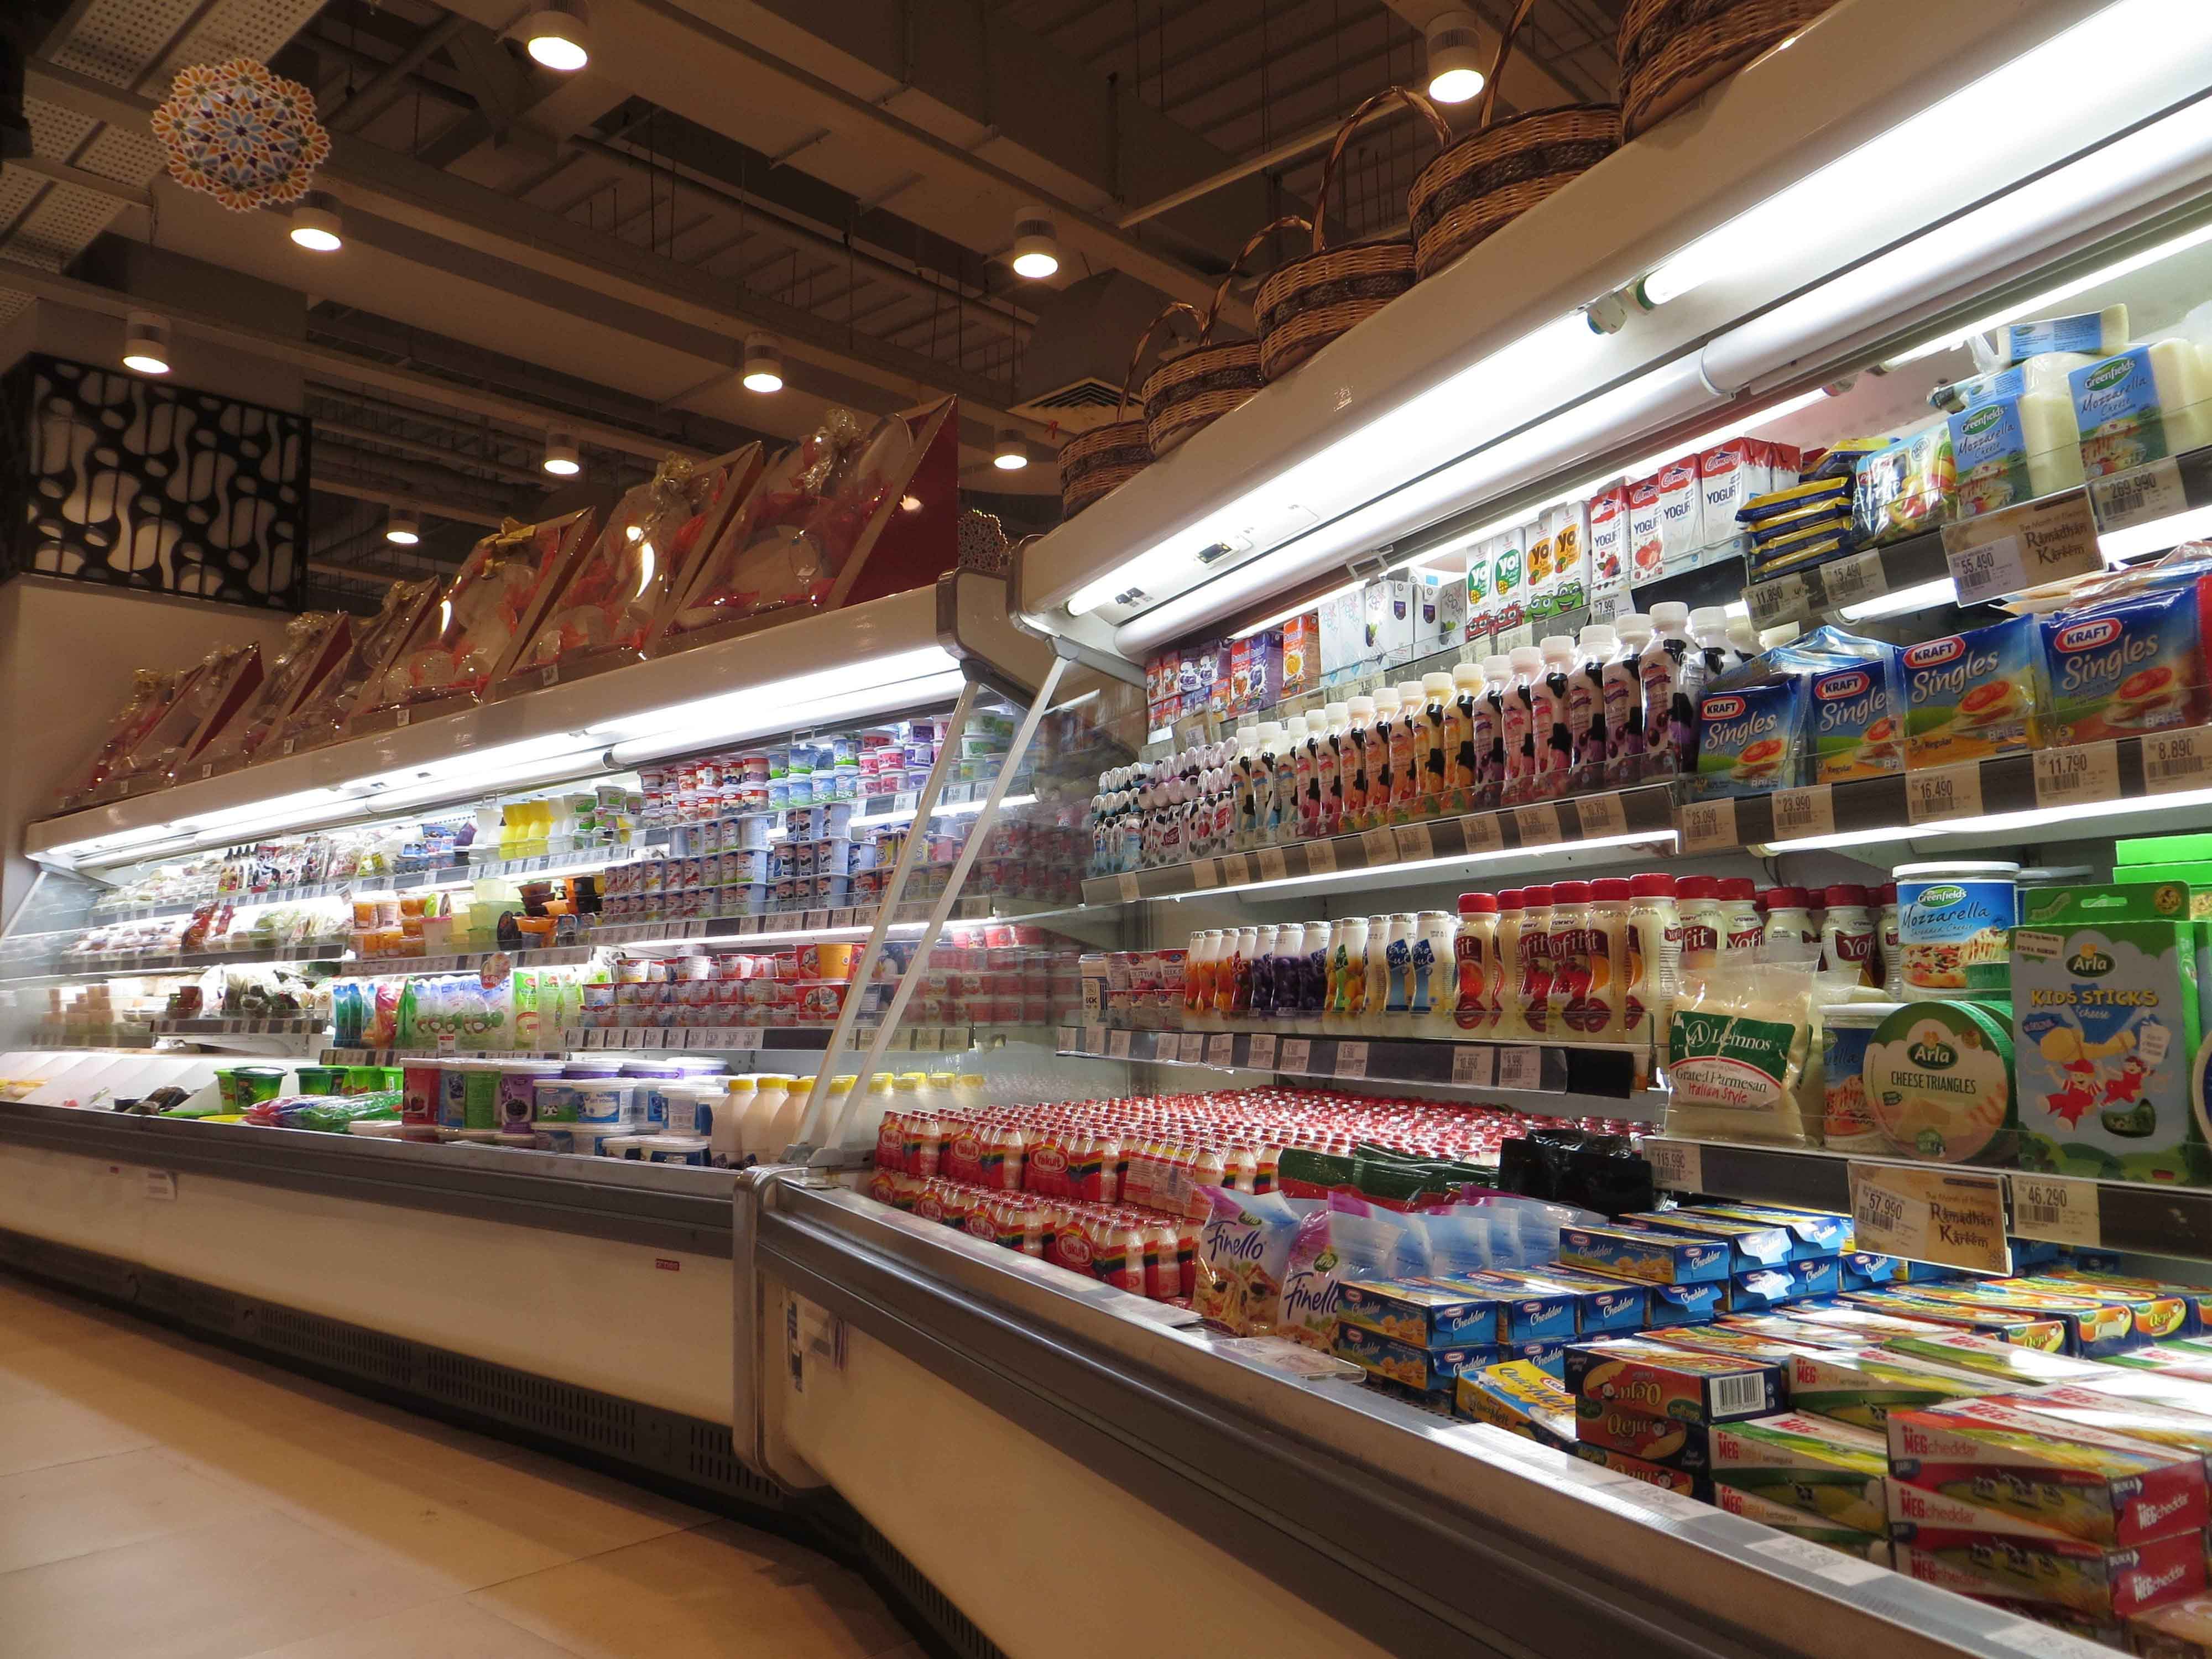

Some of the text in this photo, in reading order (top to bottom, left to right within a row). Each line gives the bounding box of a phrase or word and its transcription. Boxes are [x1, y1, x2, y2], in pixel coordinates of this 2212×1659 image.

[2085, 359, 2136, 388] Greenfields
[1961, 406, 2005, 431] Greenfields
[1707, 483, 1740, 504] YOGURT
[1664, 498, 1694, 519] YOGURT
[1634, 516, 1662, 535] YOGURT
[1594, 528, 1621, 547] YOGURT
[1960, 553, 1994, 575] 55.490
[2067, 625, 2109, 645] KRAFT
[1914, 643, 1954, 661] KRAFT
[2062, 633, 2158, 691] Singles
[1825, 678, 1859, 693] KRAFT
[1912, 649, 2000, 704] Singles
[1707, 702, 1737, 713] KRAFT
[1820, 687, 1887, 732] Single
[1705, 711, 1777, 750] Singles
[2159, 739, 2194, 760] 8.890
[2049, 755, 2087, 774] 11.790
[1921, 780, 1952, 799] 16.490
[1783, 796, 1811, 812] 23.990
[1918, 889, 1968, 902] Greenfields
[1902, 901, 1989, 928] Mozzarella
[1685, 929, 1708, 951] fit
[1844, 937, 1874, 963] Yof
[2074, 959, 2106, 971] Arla
[2030, 990, 2159, 1007] KIDS STICKS
[1915, 1046, 1949, 1064] Arla
[1676, 1068, 1708, 1083] Grated
[1891, 1071, 1976, 1095] CHEESE TRIANGLES
[1688, 1082, 1747, 1104] Italian Style
[1037, 1153, 1062, 1167] Yakult
[2028, 1185, 2067, 1207] 46.290
[1869, 1194, 1902, 1220] 57.990
[1205, 1220, 1265, 1261] Finello
[1530, 1305, 1564, 1326] Cheddar
[1603, 1297, 1634, 1318] Cheddar
[1452, 1309, 1486, 1331] Cheddar
[1453, 1354, 1487, 1376] Cheddar
